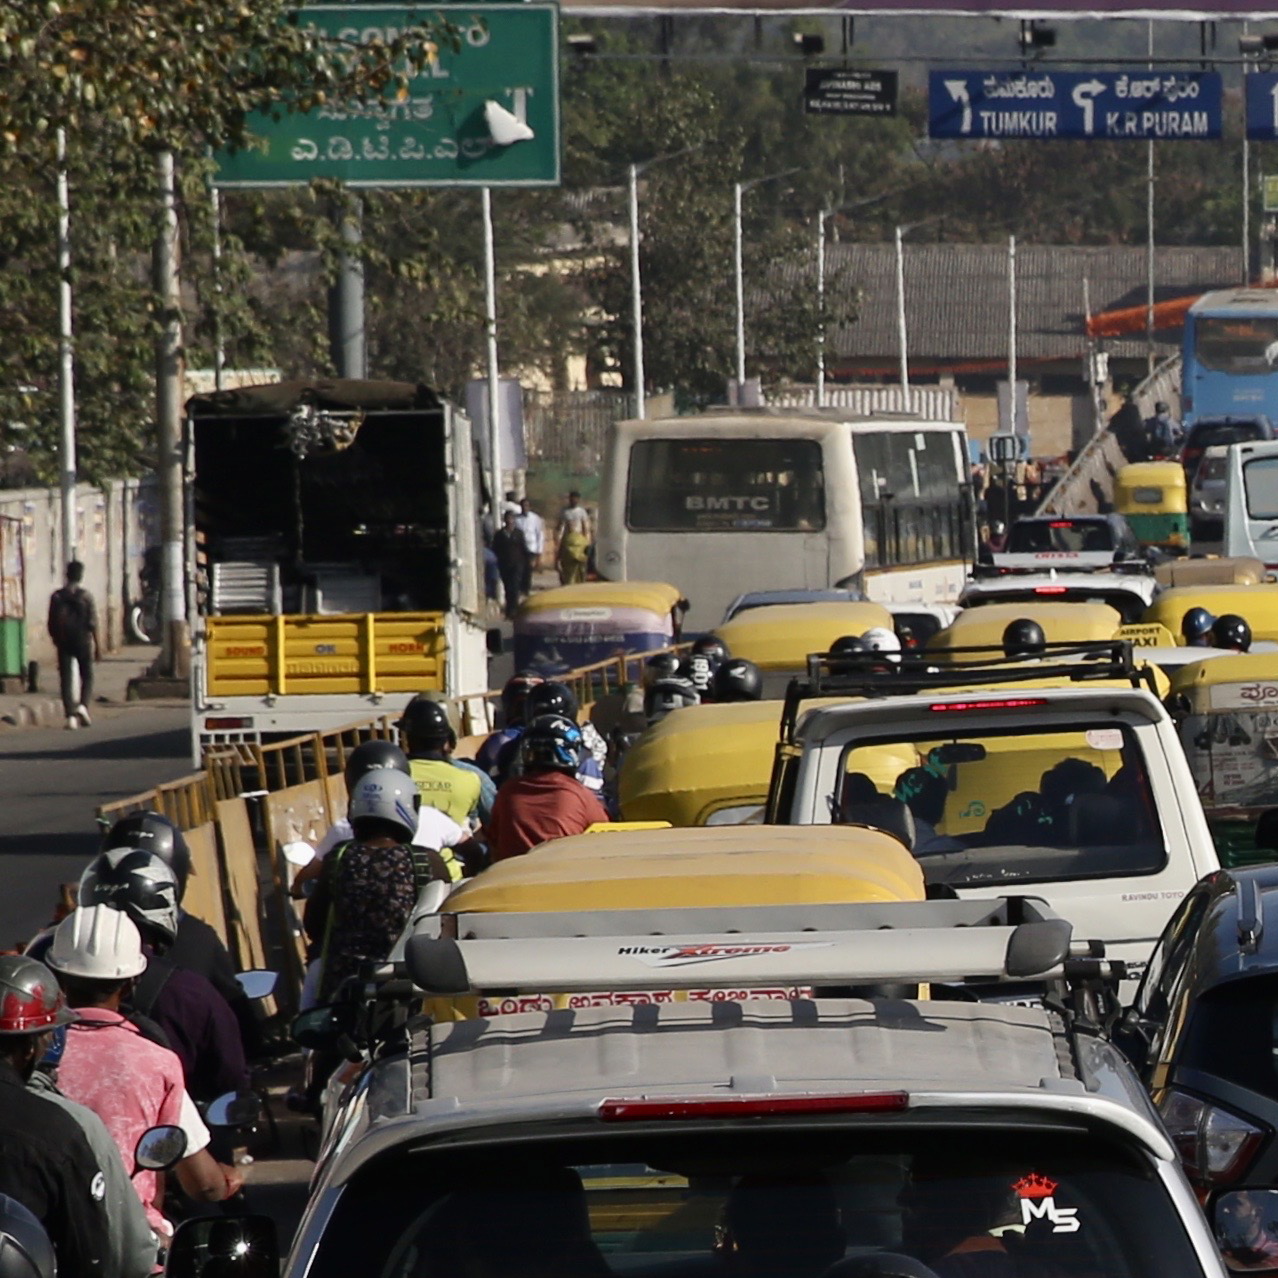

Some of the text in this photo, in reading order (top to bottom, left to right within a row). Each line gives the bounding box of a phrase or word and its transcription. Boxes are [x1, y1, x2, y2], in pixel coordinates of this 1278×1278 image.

[980, 111, 1209, 137] TUMKUR K.R.PURAM
[685, 495, 770, 511] BMTC
[1120, 627, 1160, 636] AIRPORT
[226, 646, 265, 656] SOUND
[315, 644, 337, 655] OK
[388, 642, 426, 654] HORN
[618, 946, 670, 956] Hiker
